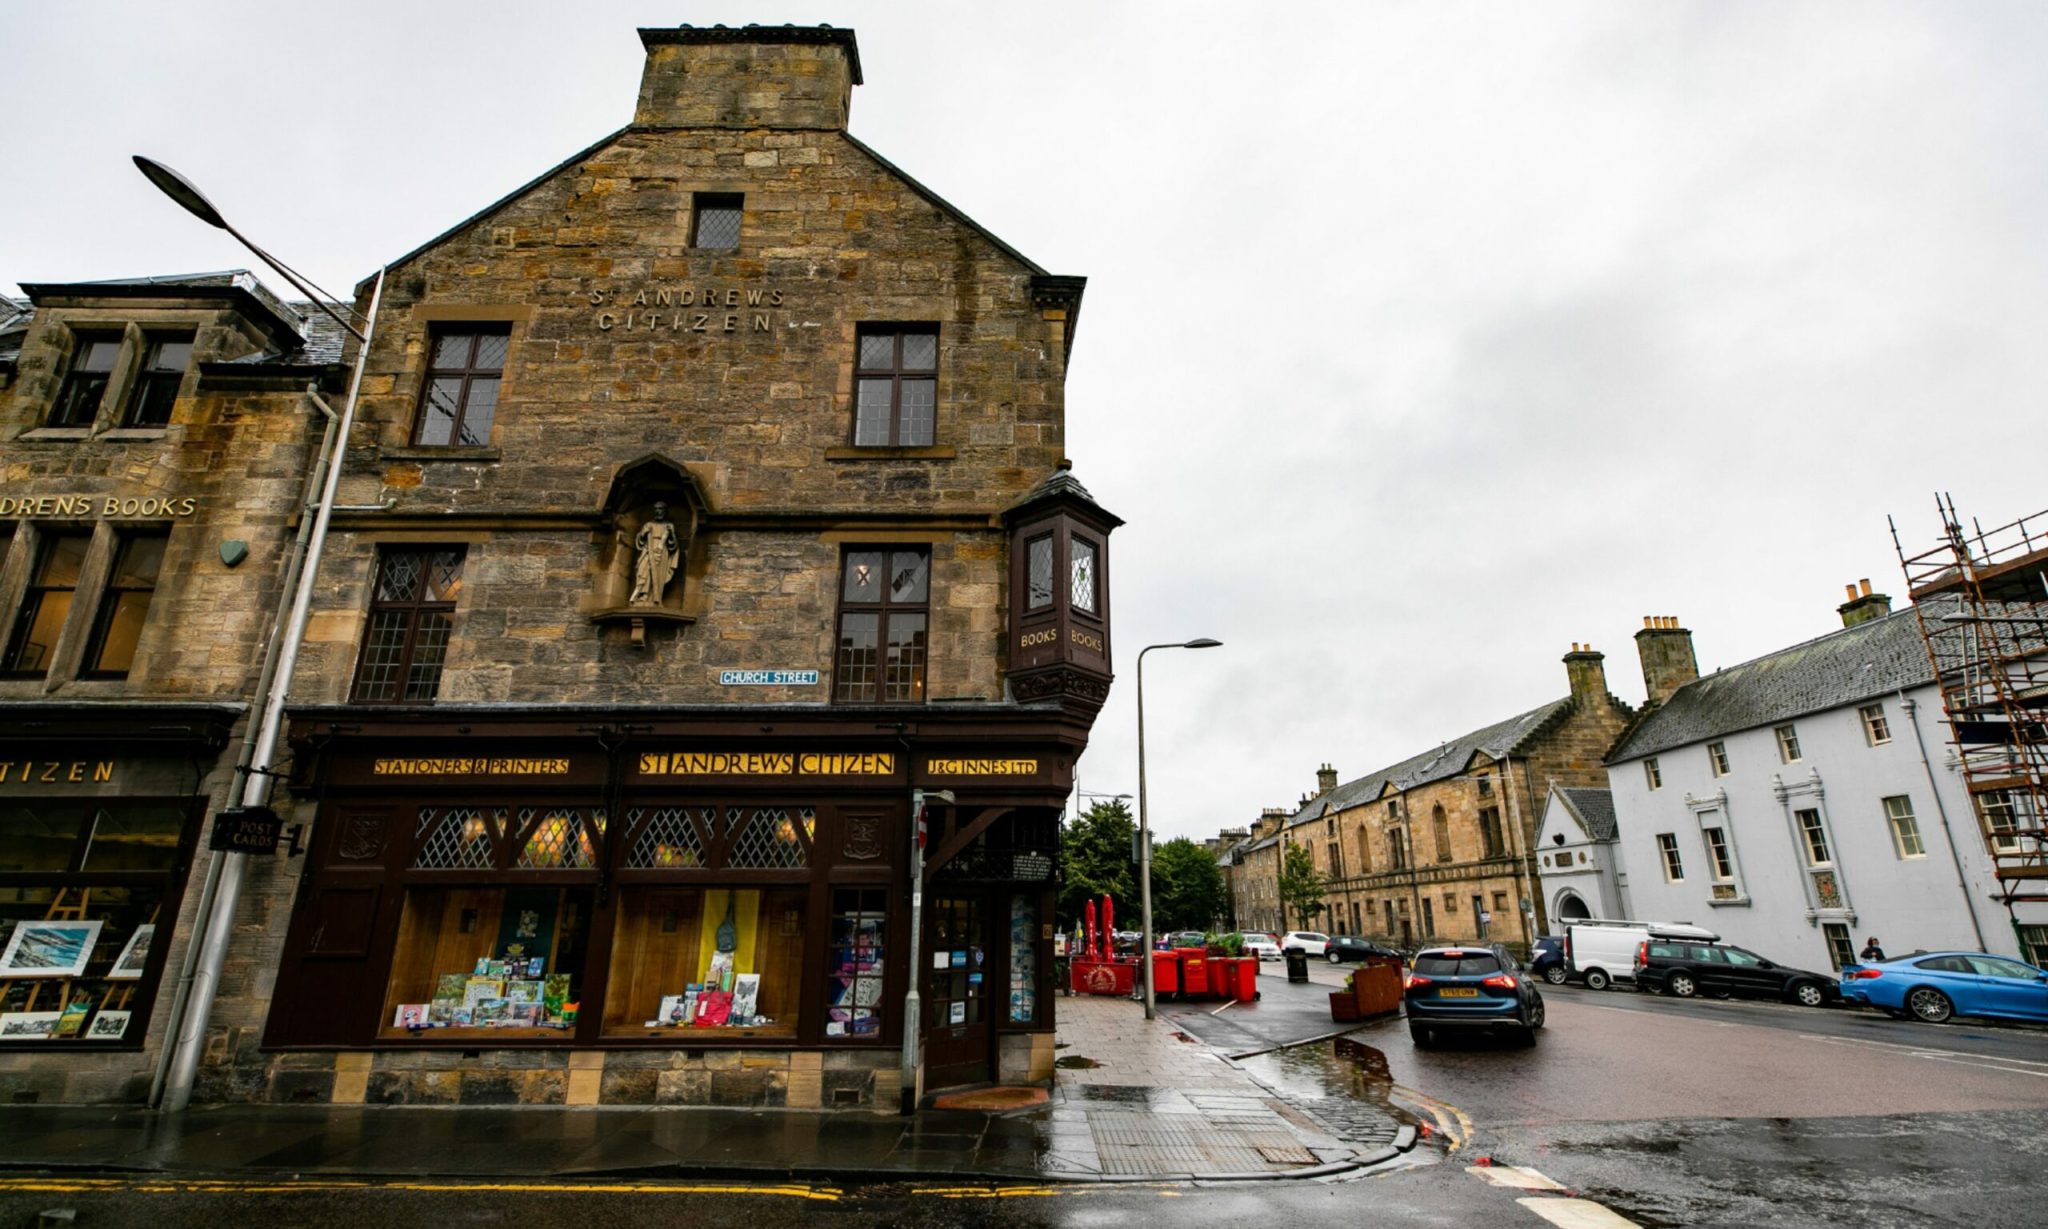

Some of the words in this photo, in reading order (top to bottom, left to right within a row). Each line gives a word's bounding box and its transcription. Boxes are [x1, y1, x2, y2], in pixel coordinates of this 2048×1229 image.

[633, 288, 784, 307] ANDREWS
[599, 313, 771, 332] CITIZEN
[103, 497, 197, 516] BOOKS
[1021, 628, 1056, 647] BOOKS
[1071, 629, 1103, 652] BOOKS
[723, 672, 768, 683] CHURCH
[774, 672, 815, 683] STREET
[374, 759, 472, 775] STATIONERS
[474, 759, 487, 774] &
[489, 759, 569, 775] PRINTERS
[639, 753, 668, 775] ST
[672, 753, 793, 775] ANDREWS
[799, 753, 894, 775] CITIZEN
[961, 760, 1008, 774] INNES
[1011, 760, 1037, 774] LTD
[239, 820, 273, 834] POST
[232, 833, 273, 847] CARDS
